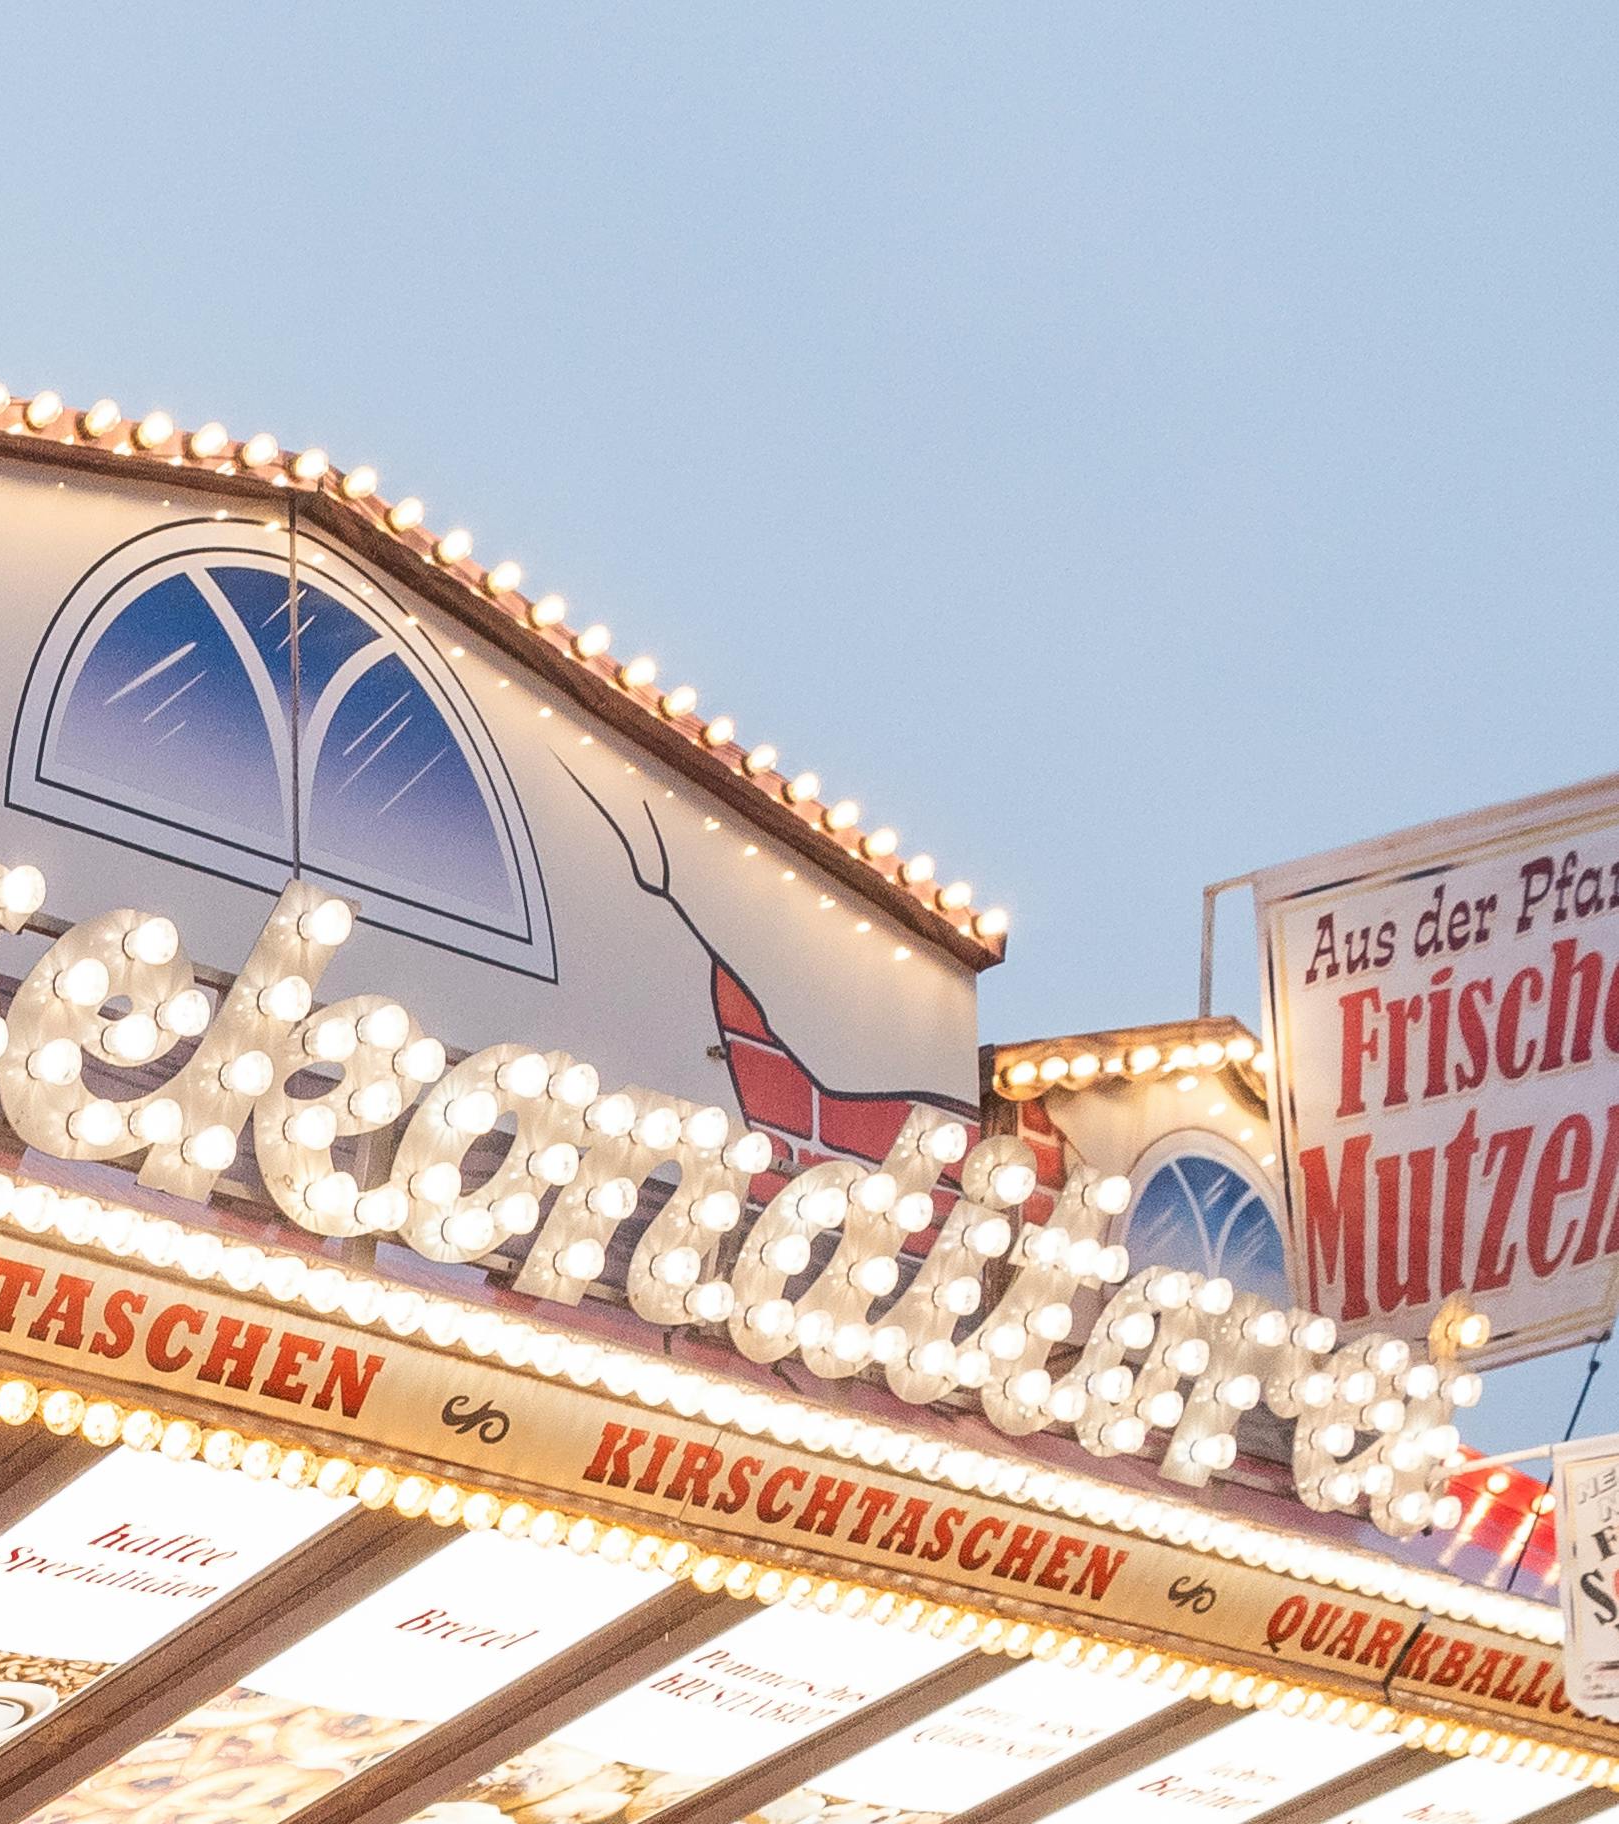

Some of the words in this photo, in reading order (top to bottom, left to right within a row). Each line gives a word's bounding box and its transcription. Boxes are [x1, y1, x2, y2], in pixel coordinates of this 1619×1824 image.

[1304, 911, 1397, 985] Aus
[1414, 883, 1499, 959] der
[582, 1420, 1130, 1605] KIRSCHTASCHEN
[394, 1607, 540, 1652] Brezel
